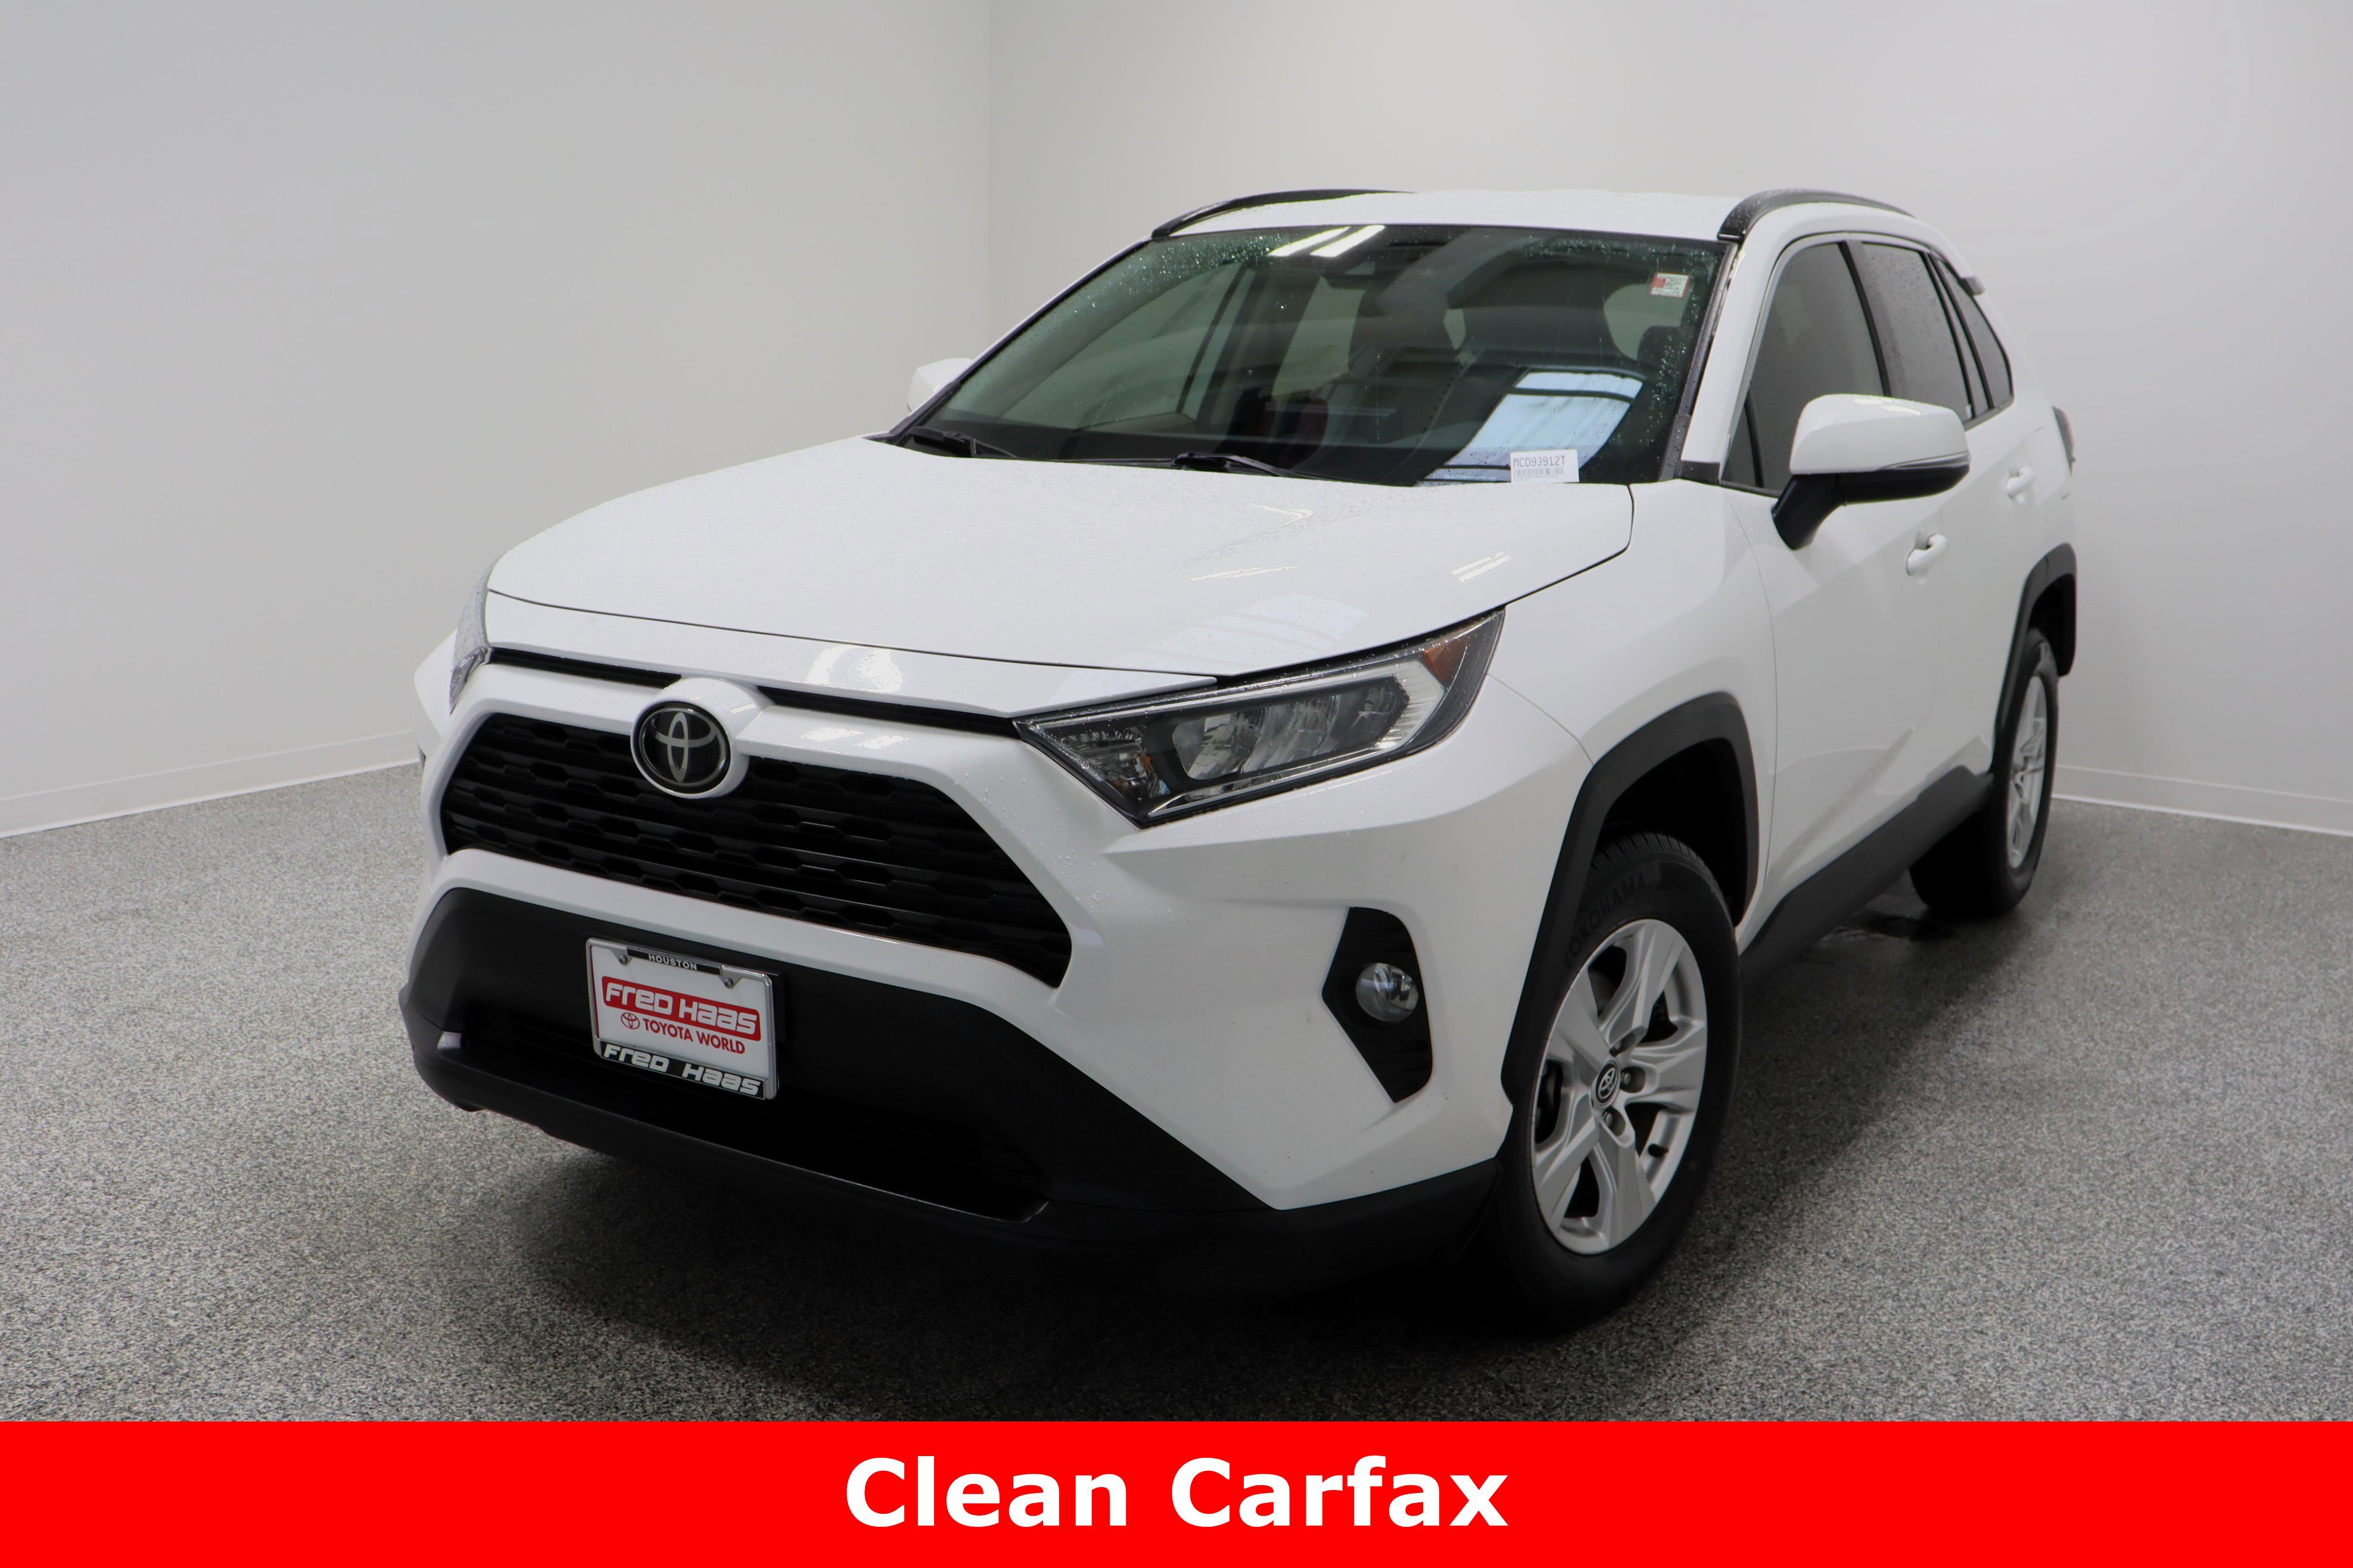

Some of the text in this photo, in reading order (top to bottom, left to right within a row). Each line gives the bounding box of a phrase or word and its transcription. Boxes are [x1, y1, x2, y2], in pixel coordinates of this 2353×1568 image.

[648, 954, 698, 971] HOUSTON
[643, 1018, 745, 1054] TOYOTA WORLD
